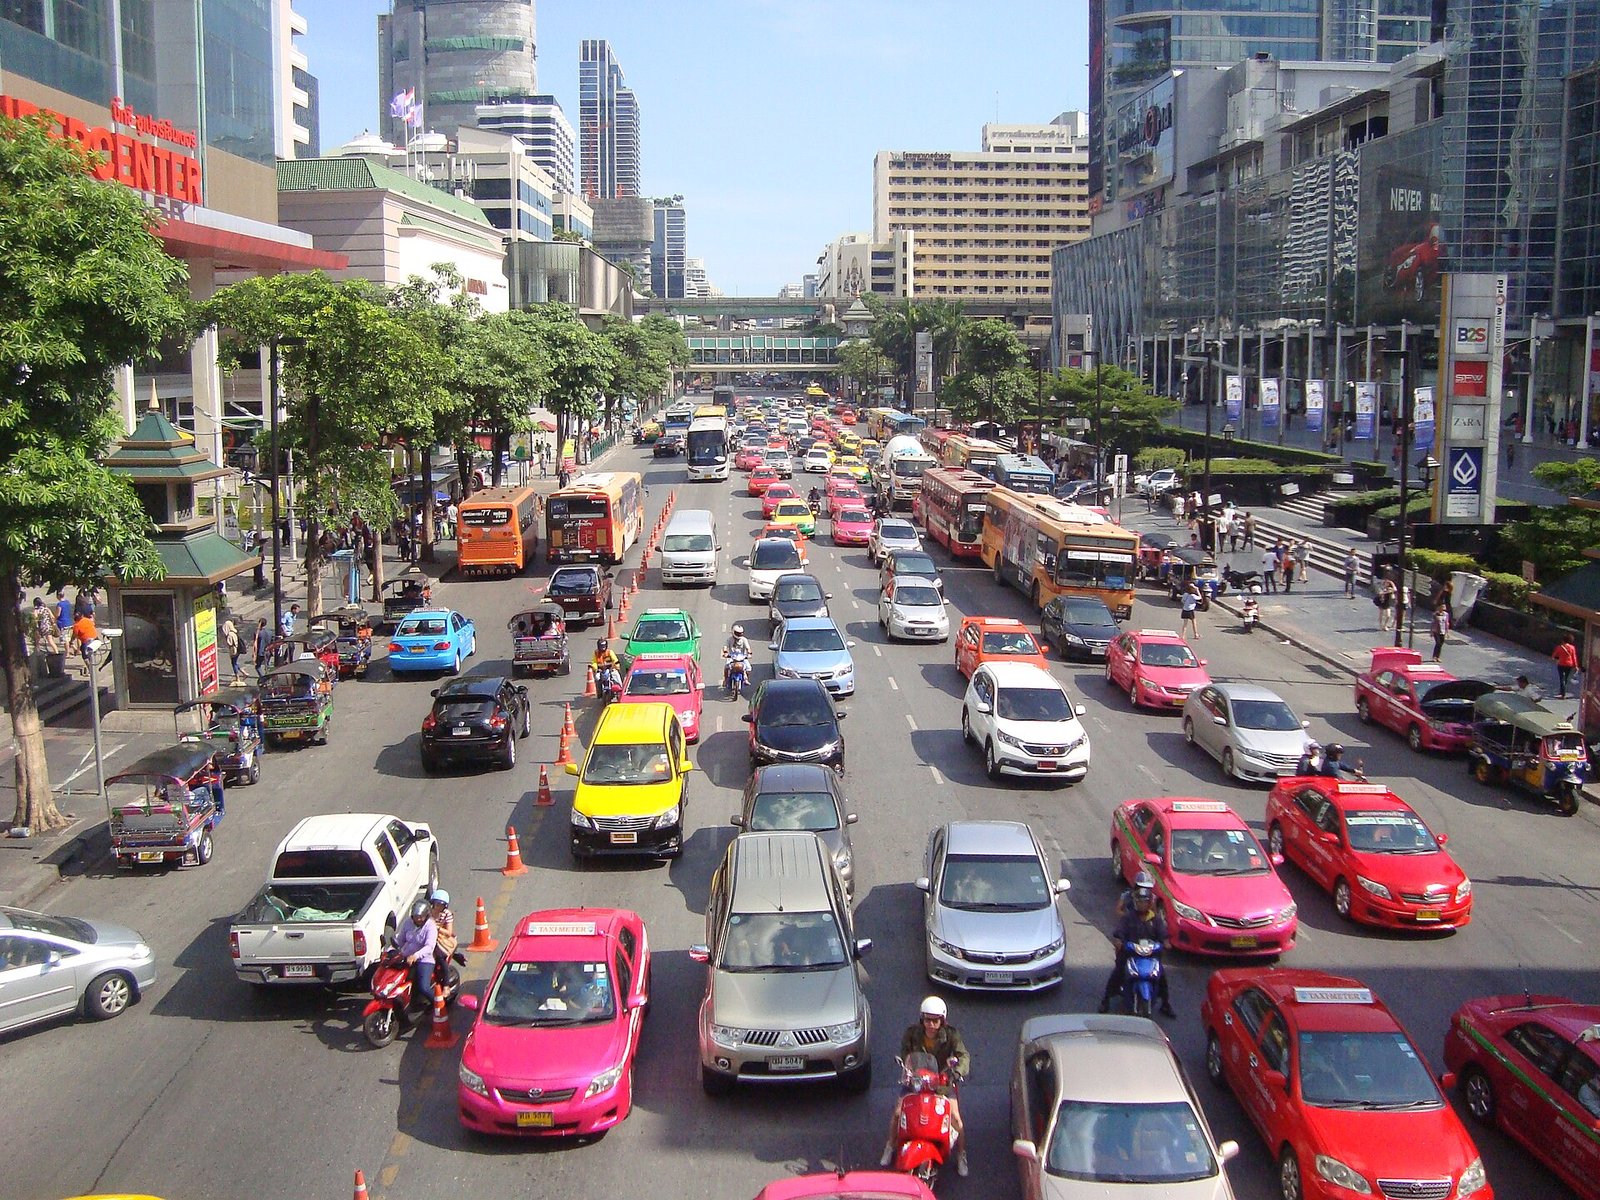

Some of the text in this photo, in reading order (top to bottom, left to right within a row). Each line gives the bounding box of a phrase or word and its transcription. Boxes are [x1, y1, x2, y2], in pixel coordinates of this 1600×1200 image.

[1390, 187, 1422, 211] NEVER
[1458, 327, 1486, 342] B2S
[1454, 418, 1482, 427] ZARA
